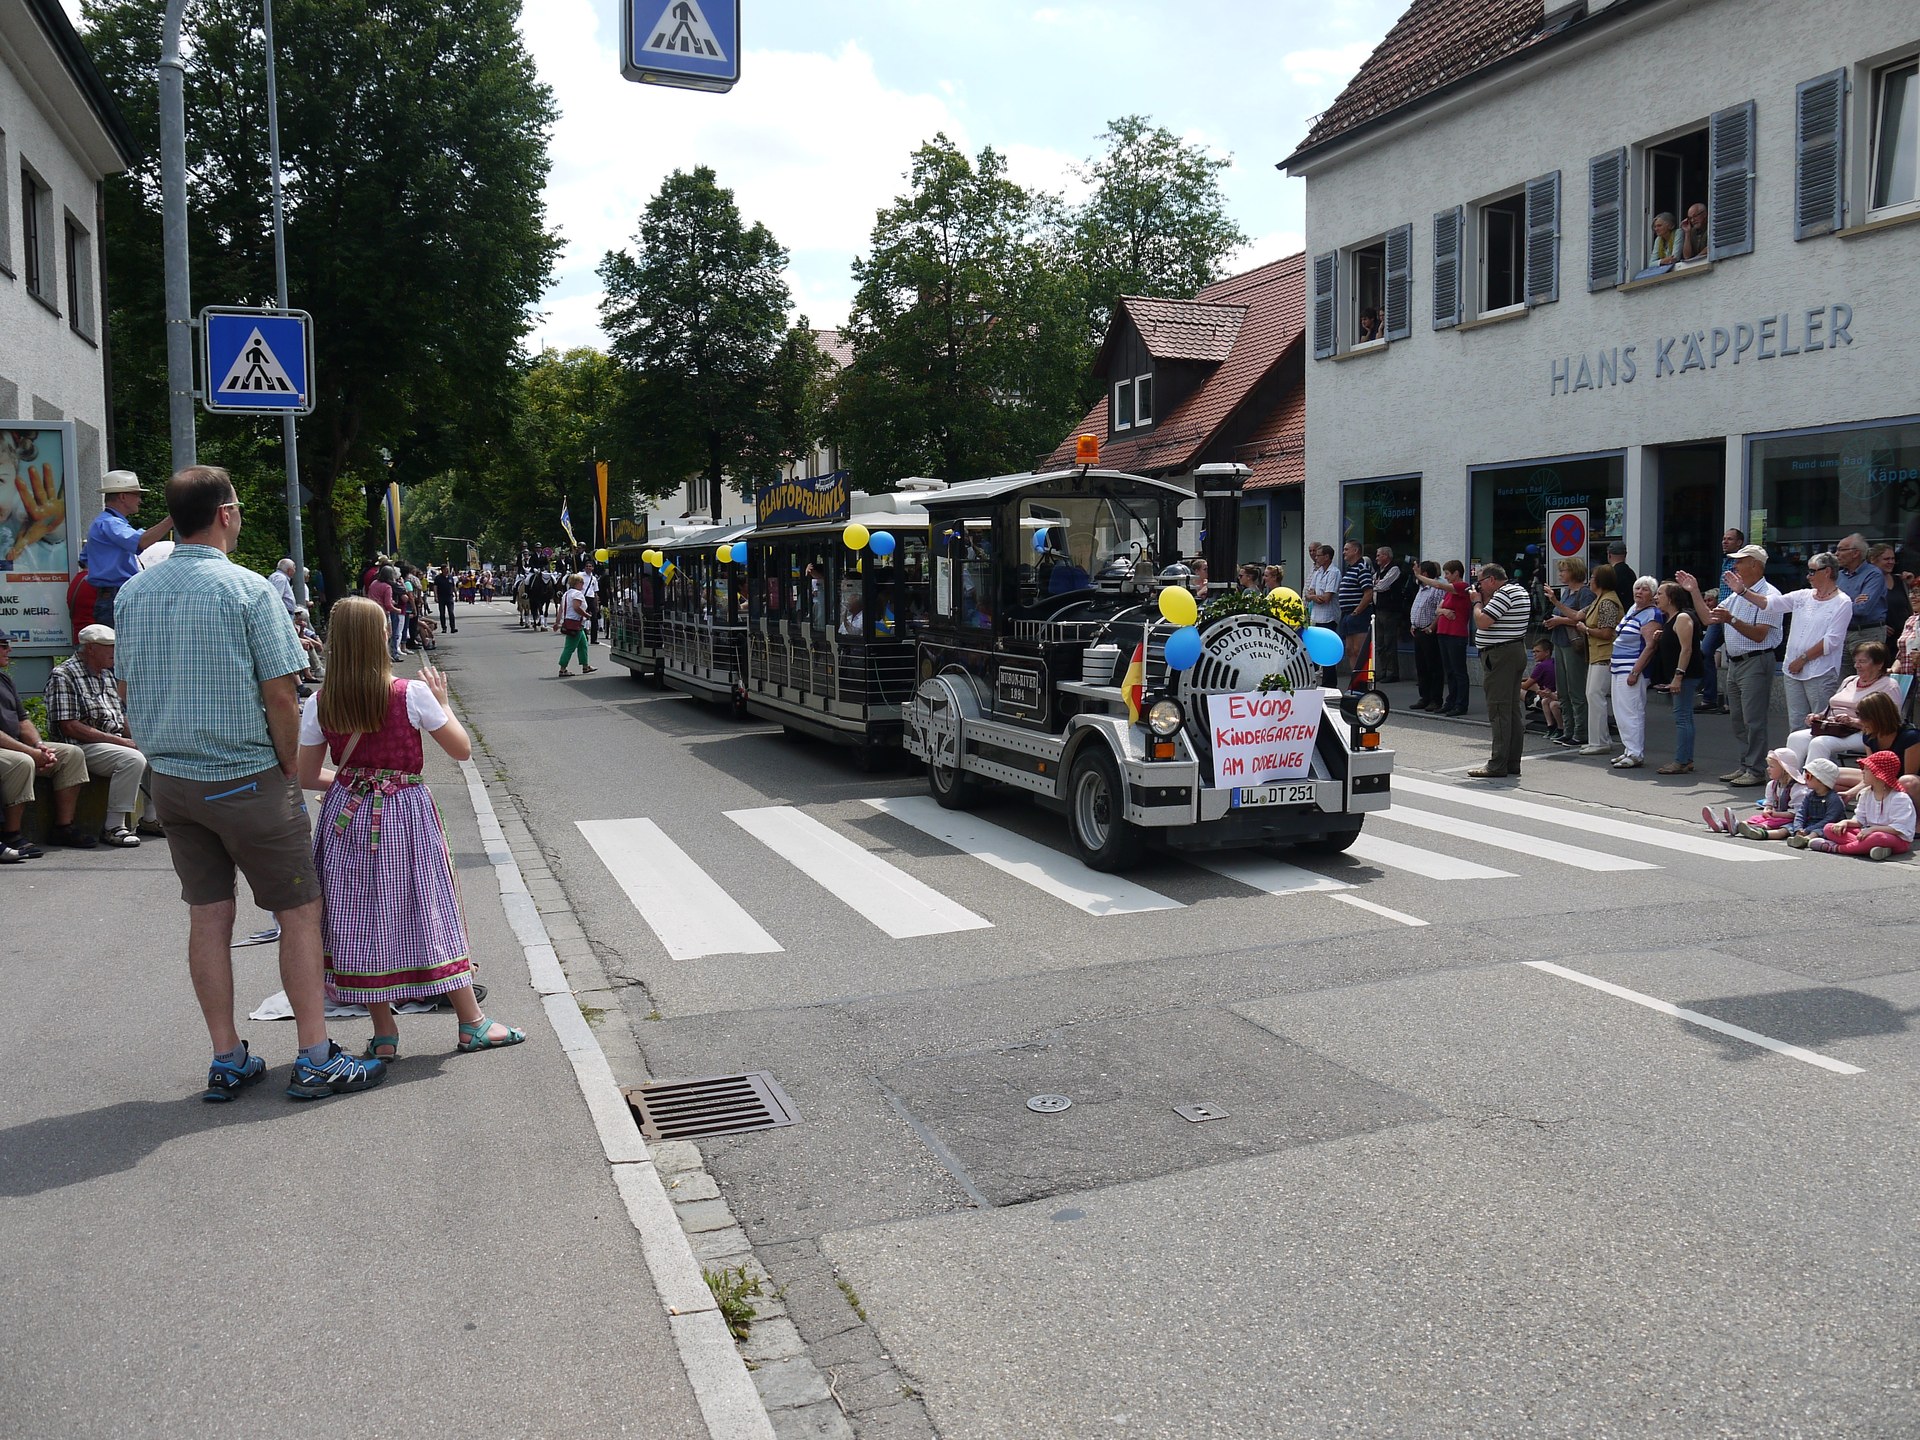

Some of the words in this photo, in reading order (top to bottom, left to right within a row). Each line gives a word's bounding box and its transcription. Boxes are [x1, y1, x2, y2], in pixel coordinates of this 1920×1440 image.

[1550, 344, 1636, 396] HANS
[1656, 302, 1854, 378] KÄPPELER
[1792, 459, 1816, 470] Rund
[1868, 467, 1920, 483] Käppe
[1545, 494, 1590, 508] Käppeler
[1382, 507, 1416, 518] Käppeler
[0, 595, 19, 604] NKE
[1210, 627, 1252, 656] DOTTO
[1257, 627, 1297, 655] TRAINS
[1225, 641, 1284, 661] CASTELFRANCO
[1249, 652, 1272, 660] ITALY
[1011, 687, 1024, 701] 1894
[1229, 696, 1294, 722] Evang.
[1223, 757, 1244, 776] AM
[1241, 789, 1258, 804] UL
[1269, 787, 1286, 803] DT
[1289, 786, 1314, 801] 251
